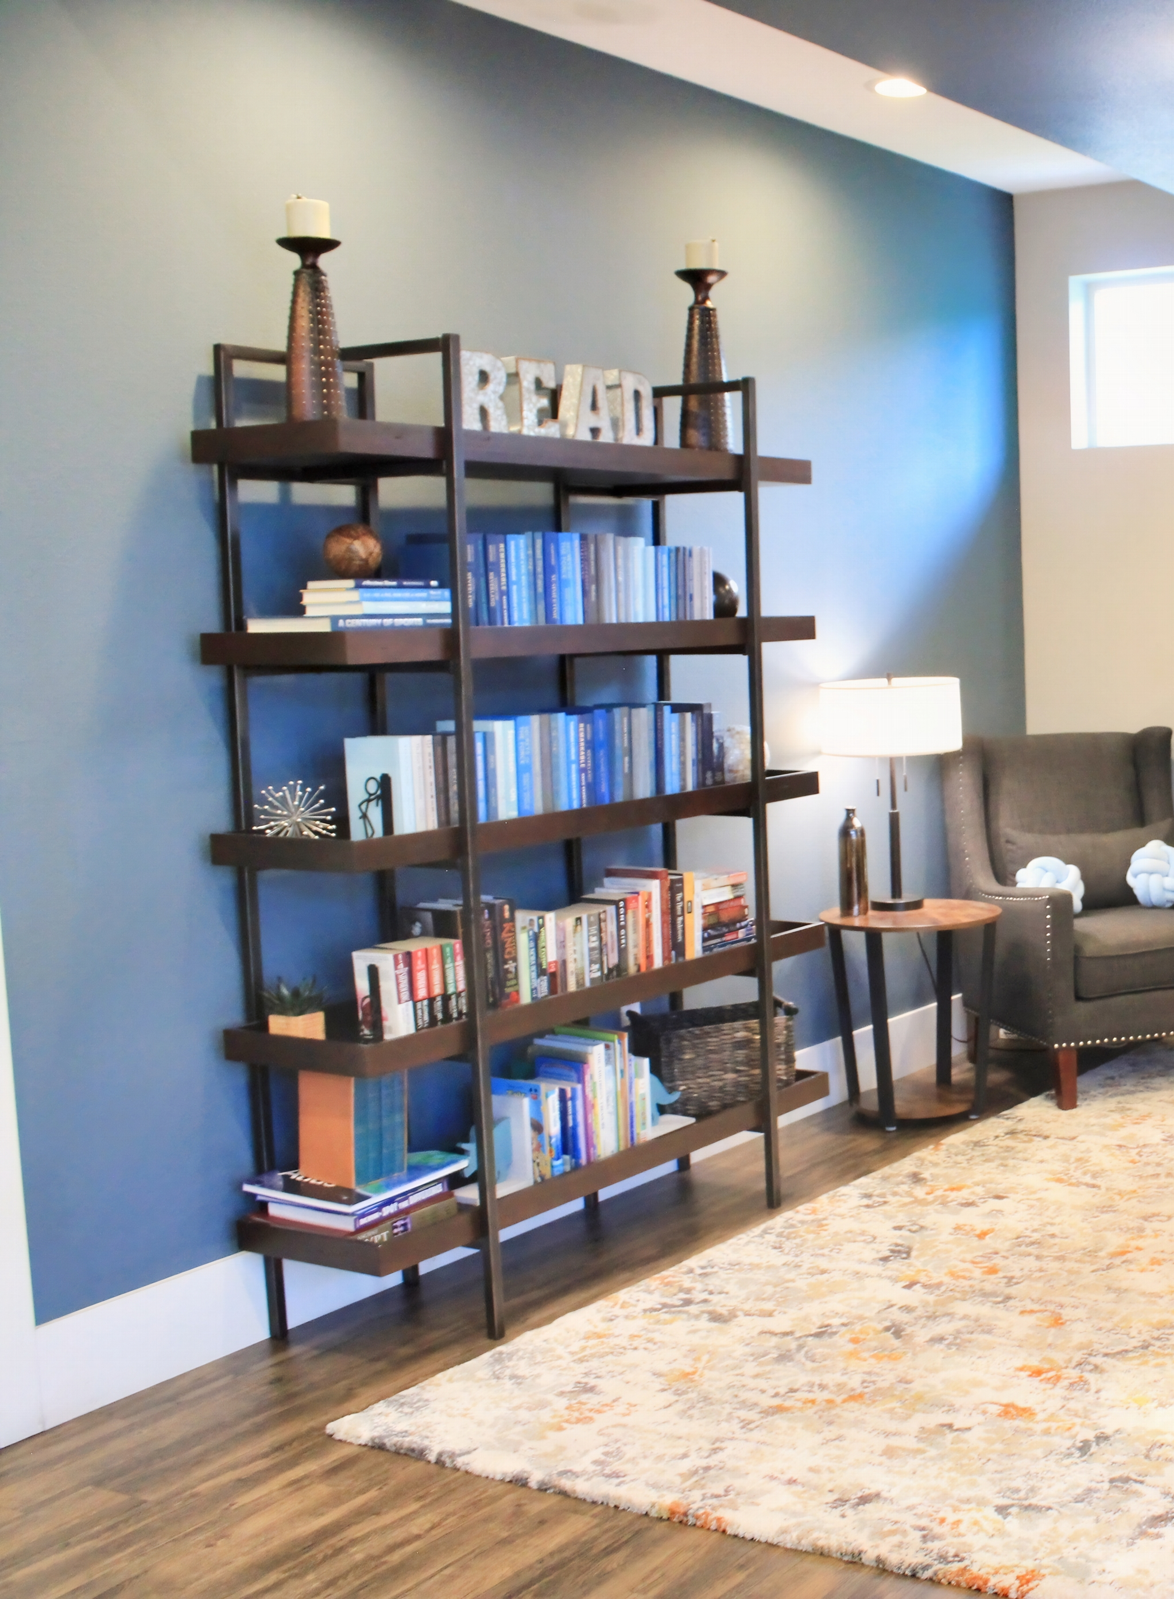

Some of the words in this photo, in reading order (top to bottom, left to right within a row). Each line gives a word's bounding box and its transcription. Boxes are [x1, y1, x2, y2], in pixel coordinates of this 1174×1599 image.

[460, 350, 656, 447] READ
[499, 543, 507, 591] REMARKABLE
[488, 571, 496, 607] NEVERLAND
[338, 619, 345, 627] A
[345, 618, 382, 627] CENTURY
[382, 618, 394, 626] OF
[394, 617, 424, 626] SPORTS
[501, 922, 516, 959] KING
